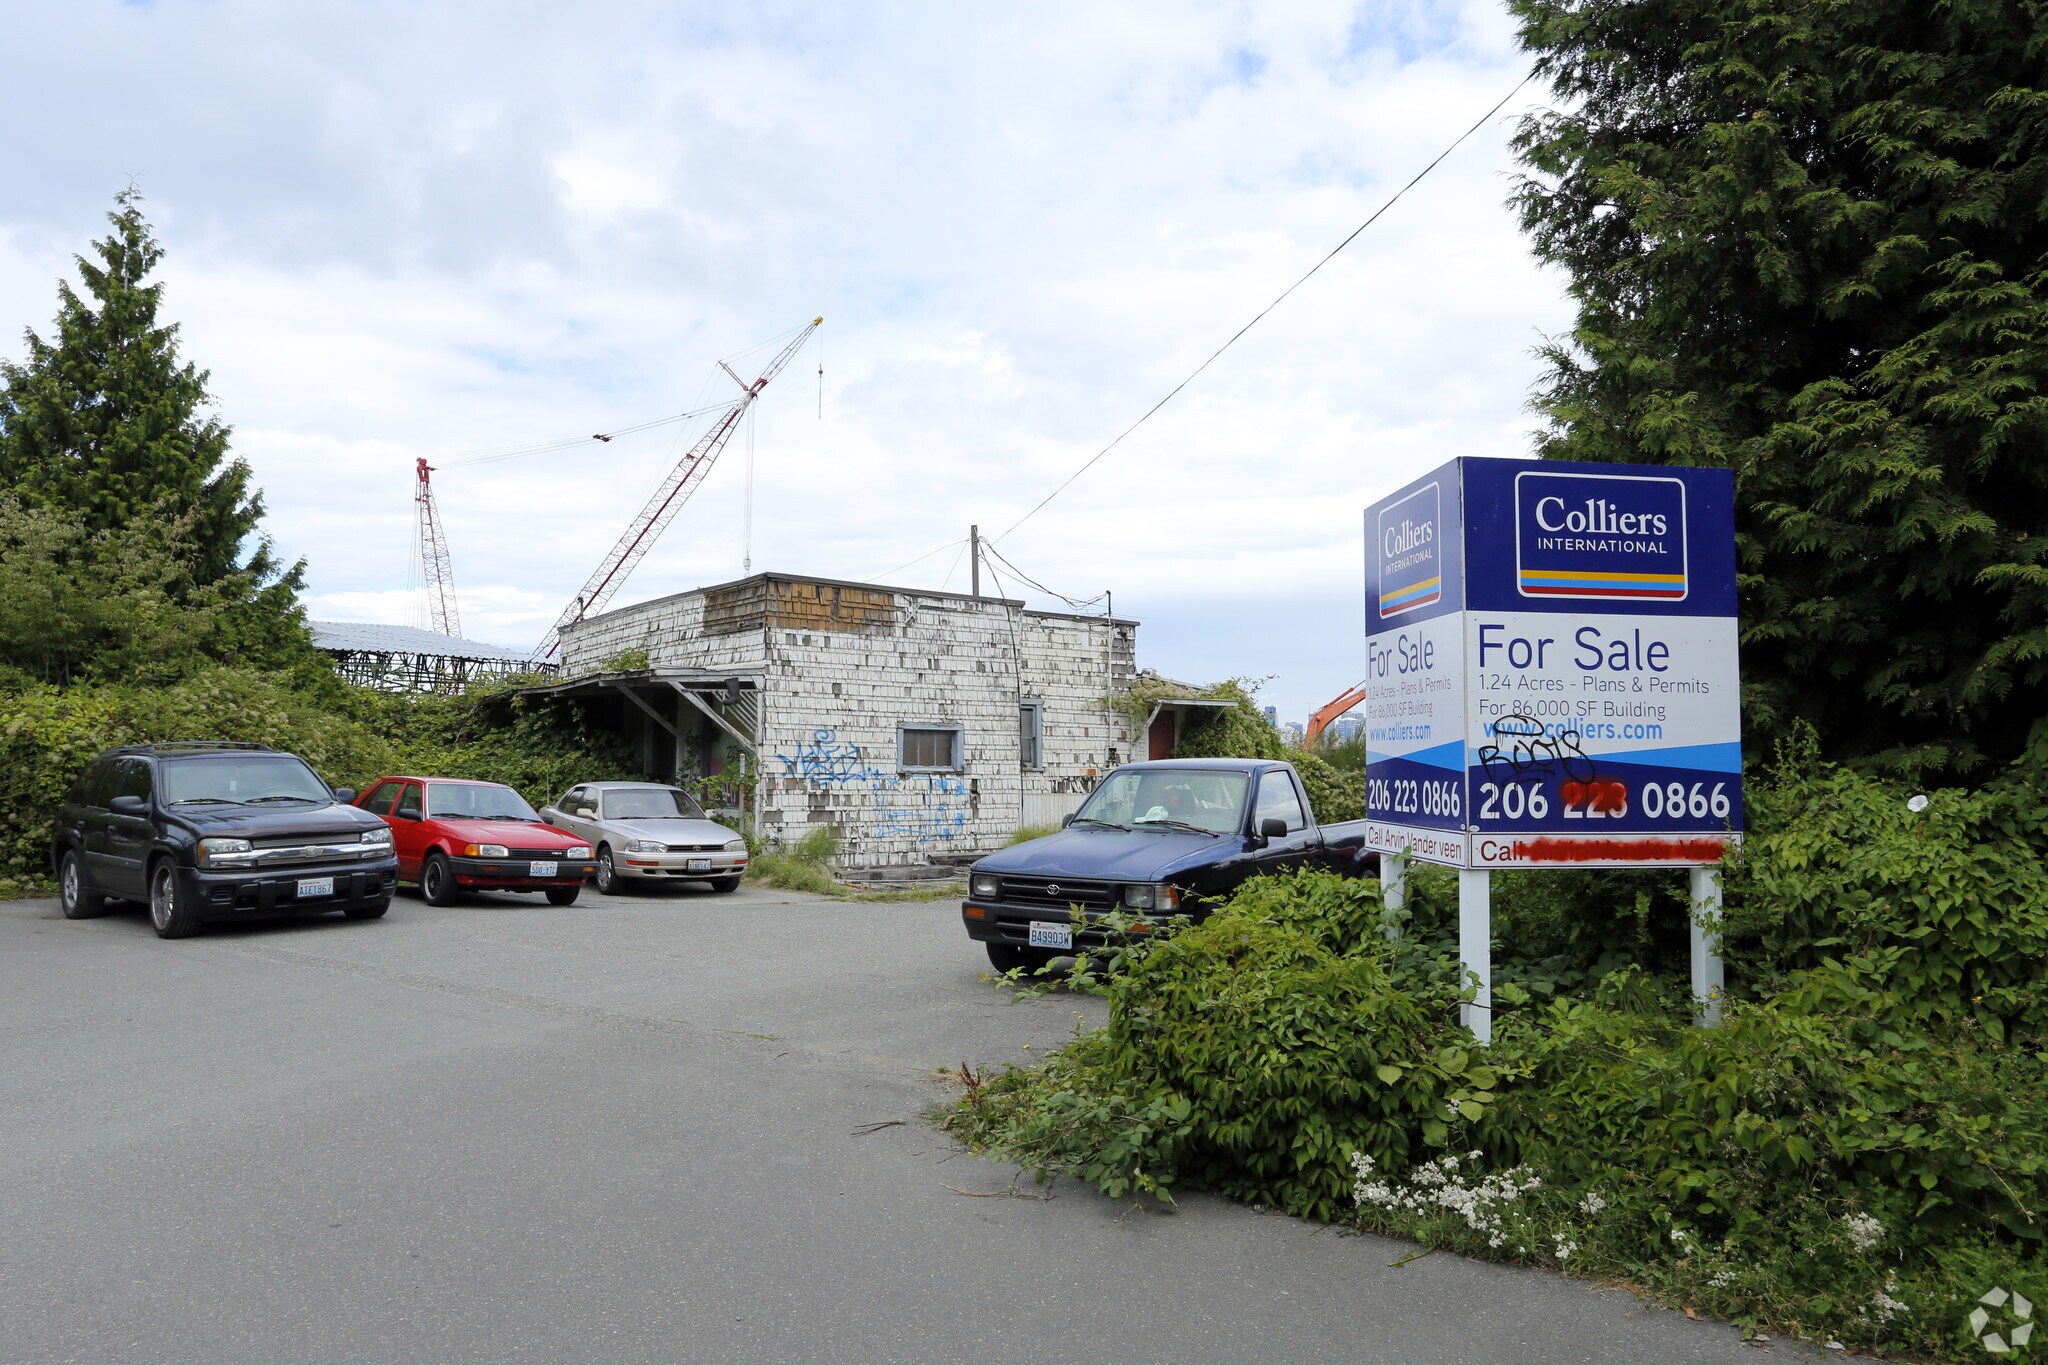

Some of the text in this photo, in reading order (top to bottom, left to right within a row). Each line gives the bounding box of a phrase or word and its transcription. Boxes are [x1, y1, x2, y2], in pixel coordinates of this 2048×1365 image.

[1535, 496, 1667, 535] Colliers
[1385, 518, 1433, 558] Colliers
[1538, 537, 1667, 554] INTERNATIONAL
[1385, 547, 1433, 575] INTERNATIONAL
[1369, 630, 1434, 679] For Sale
[1478, 624, 1670, 672] For Sale
[1401, 681, 1418, 695] Plans
[1425, 675, 1451, 692] Permits
[1479, 674, 1511, 690] 1.24
[1518, 675, 1564, 692] Acres
[1583, 675, 1626, 692] Plans
[1631, 677, 1643, 692] &
[1650, 677, 1710, 694] Permits
[1399, 701, 1407, 717] SF
[1408, 700, 1433, 717] Building
[1479, 699, 1666, 721] For 86,000 SF Building
[1370, 721, 1431, 741] www.colliers.com
[1483, 718, 1663, 740] www.colliers.com
[1369, 779, 1460, 817] 206 223 0866
[1480, 782, 1730, 819] 206 223 0866
[1369, 826, 1383, 845] Call
[1385, 829, 1405, 850] Arvin
[1407, 831, 1437, 855] Vander
